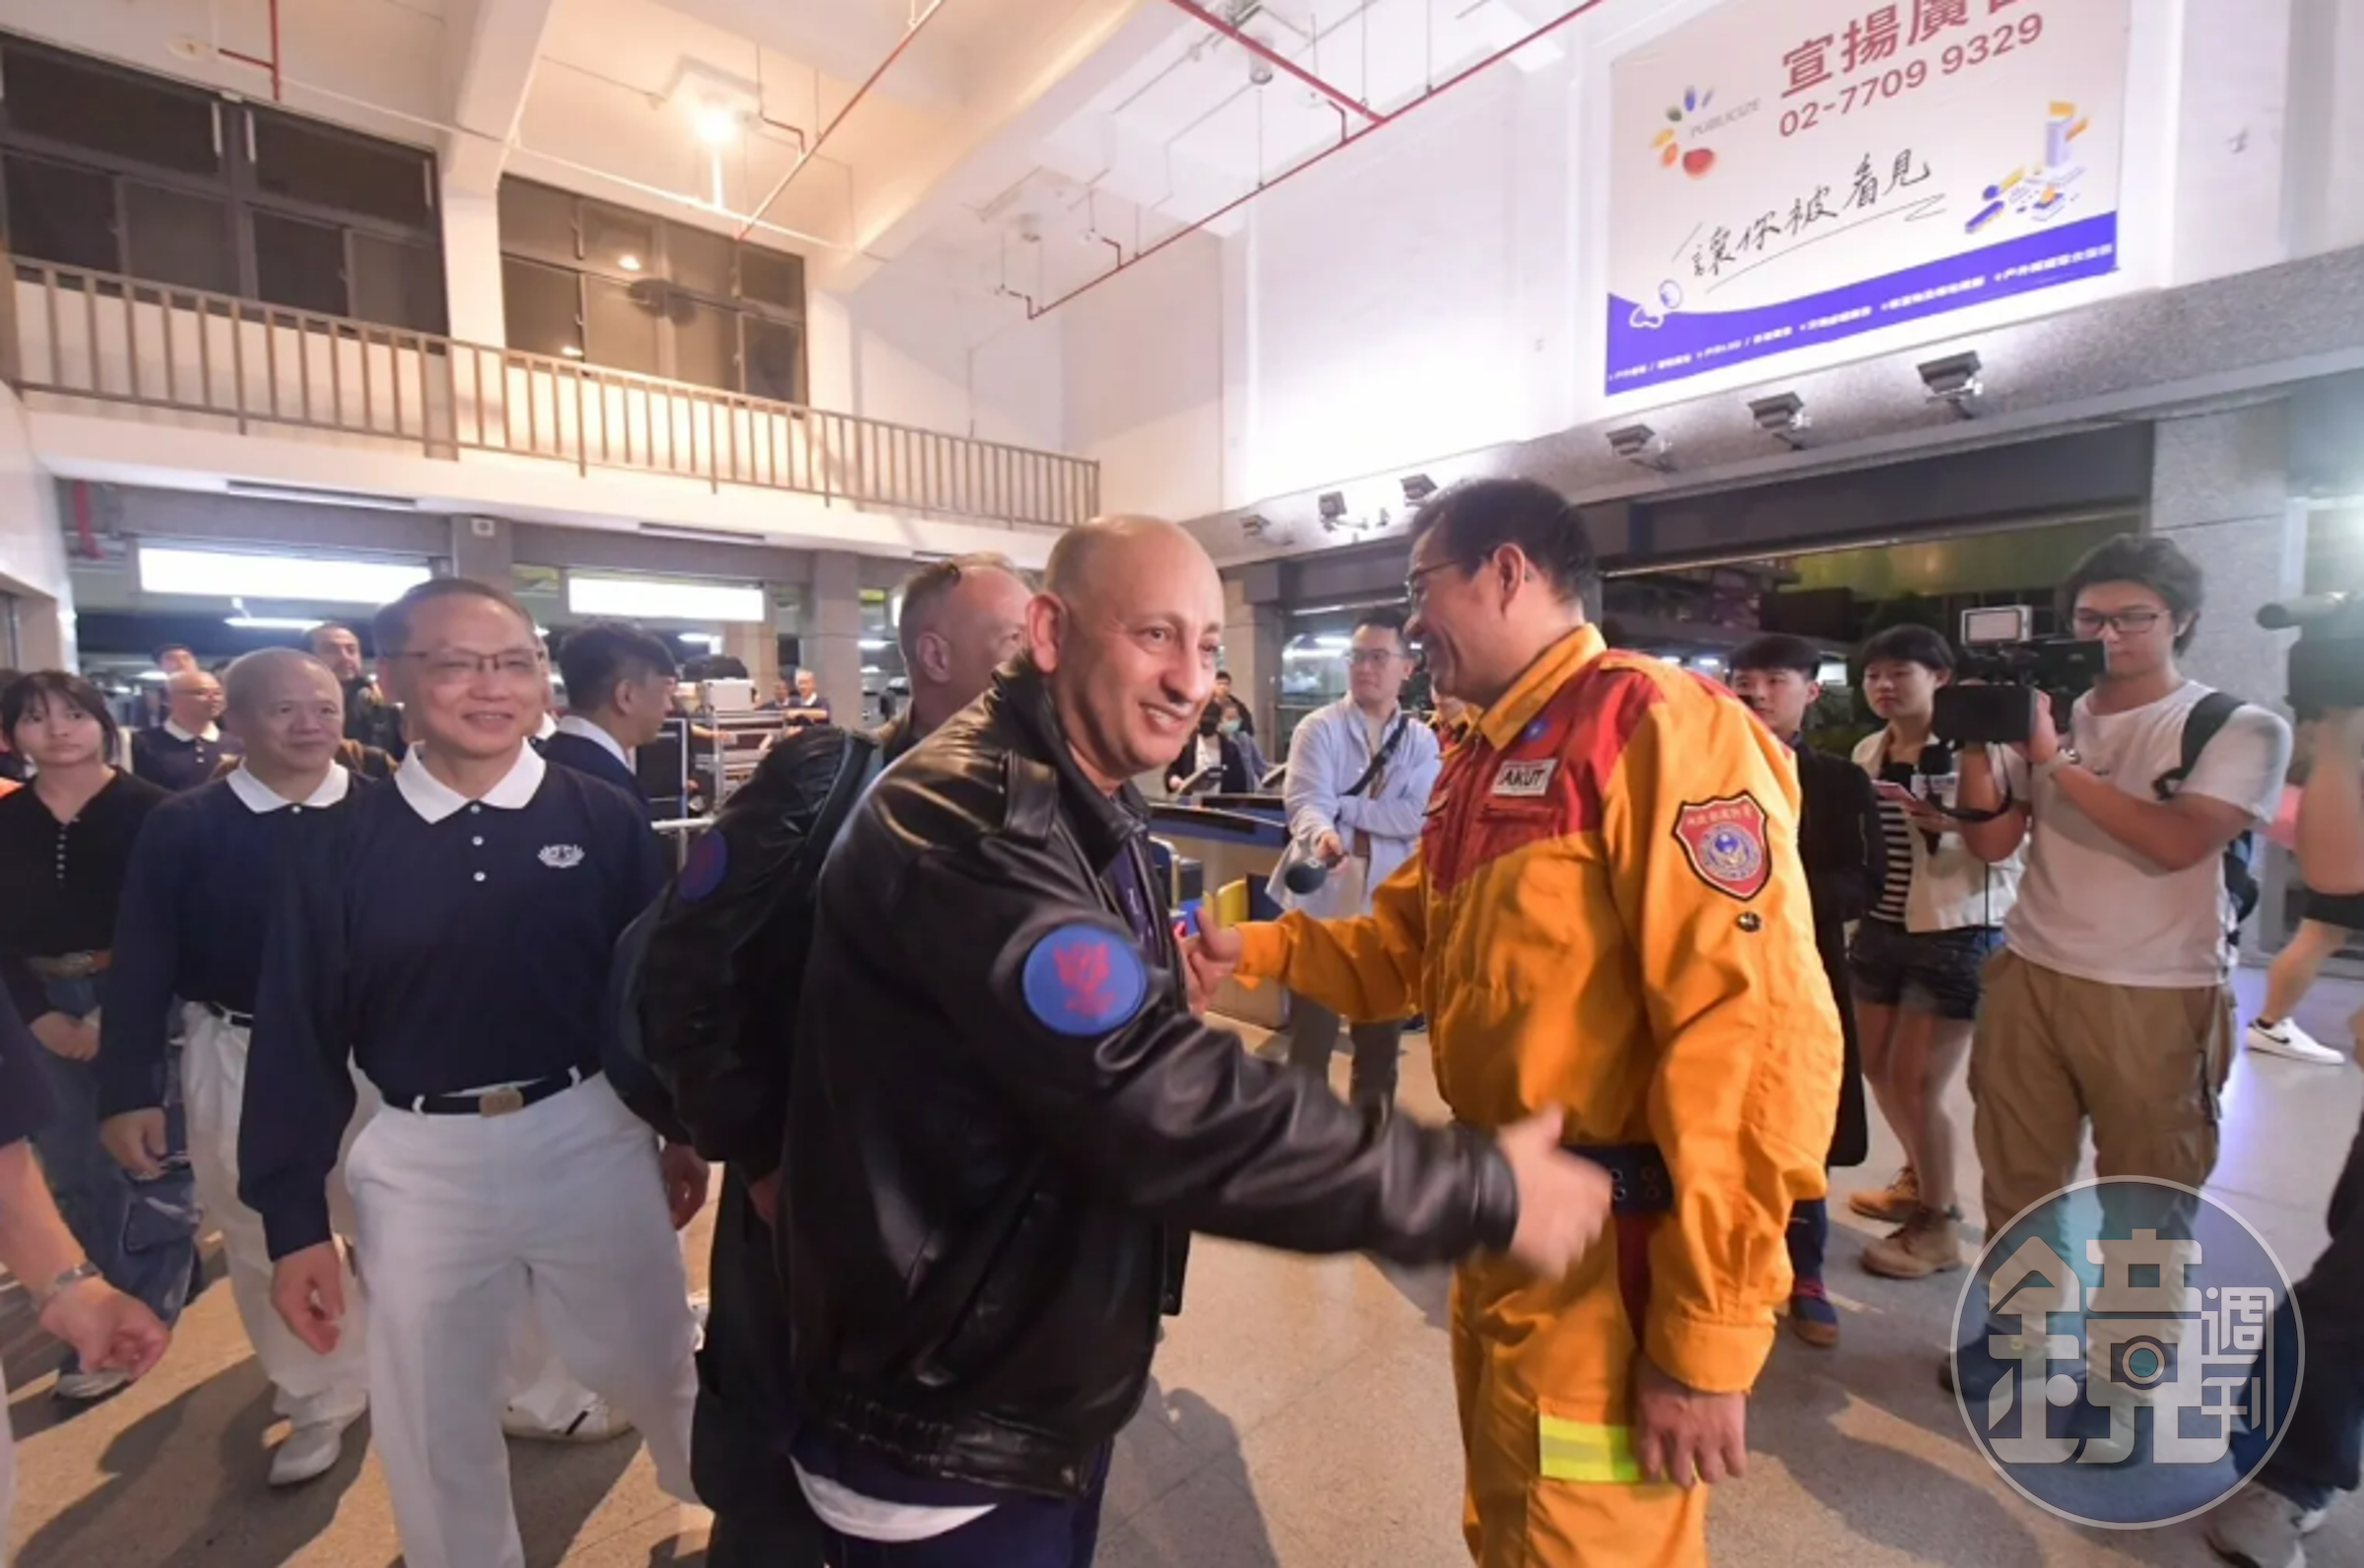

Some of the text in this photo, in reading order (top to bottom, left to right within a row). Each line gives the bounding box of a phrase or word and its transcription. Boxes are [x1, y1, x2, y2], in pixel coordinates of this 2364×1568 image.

[1779, 12, 2044, 137] 02-7709 9329
[1781, 0, 2018, 98] 宣揚廣
[1691, 148, 1932, 277] 讓你被看見
[1496, 769, 1546, 787] AKUT
